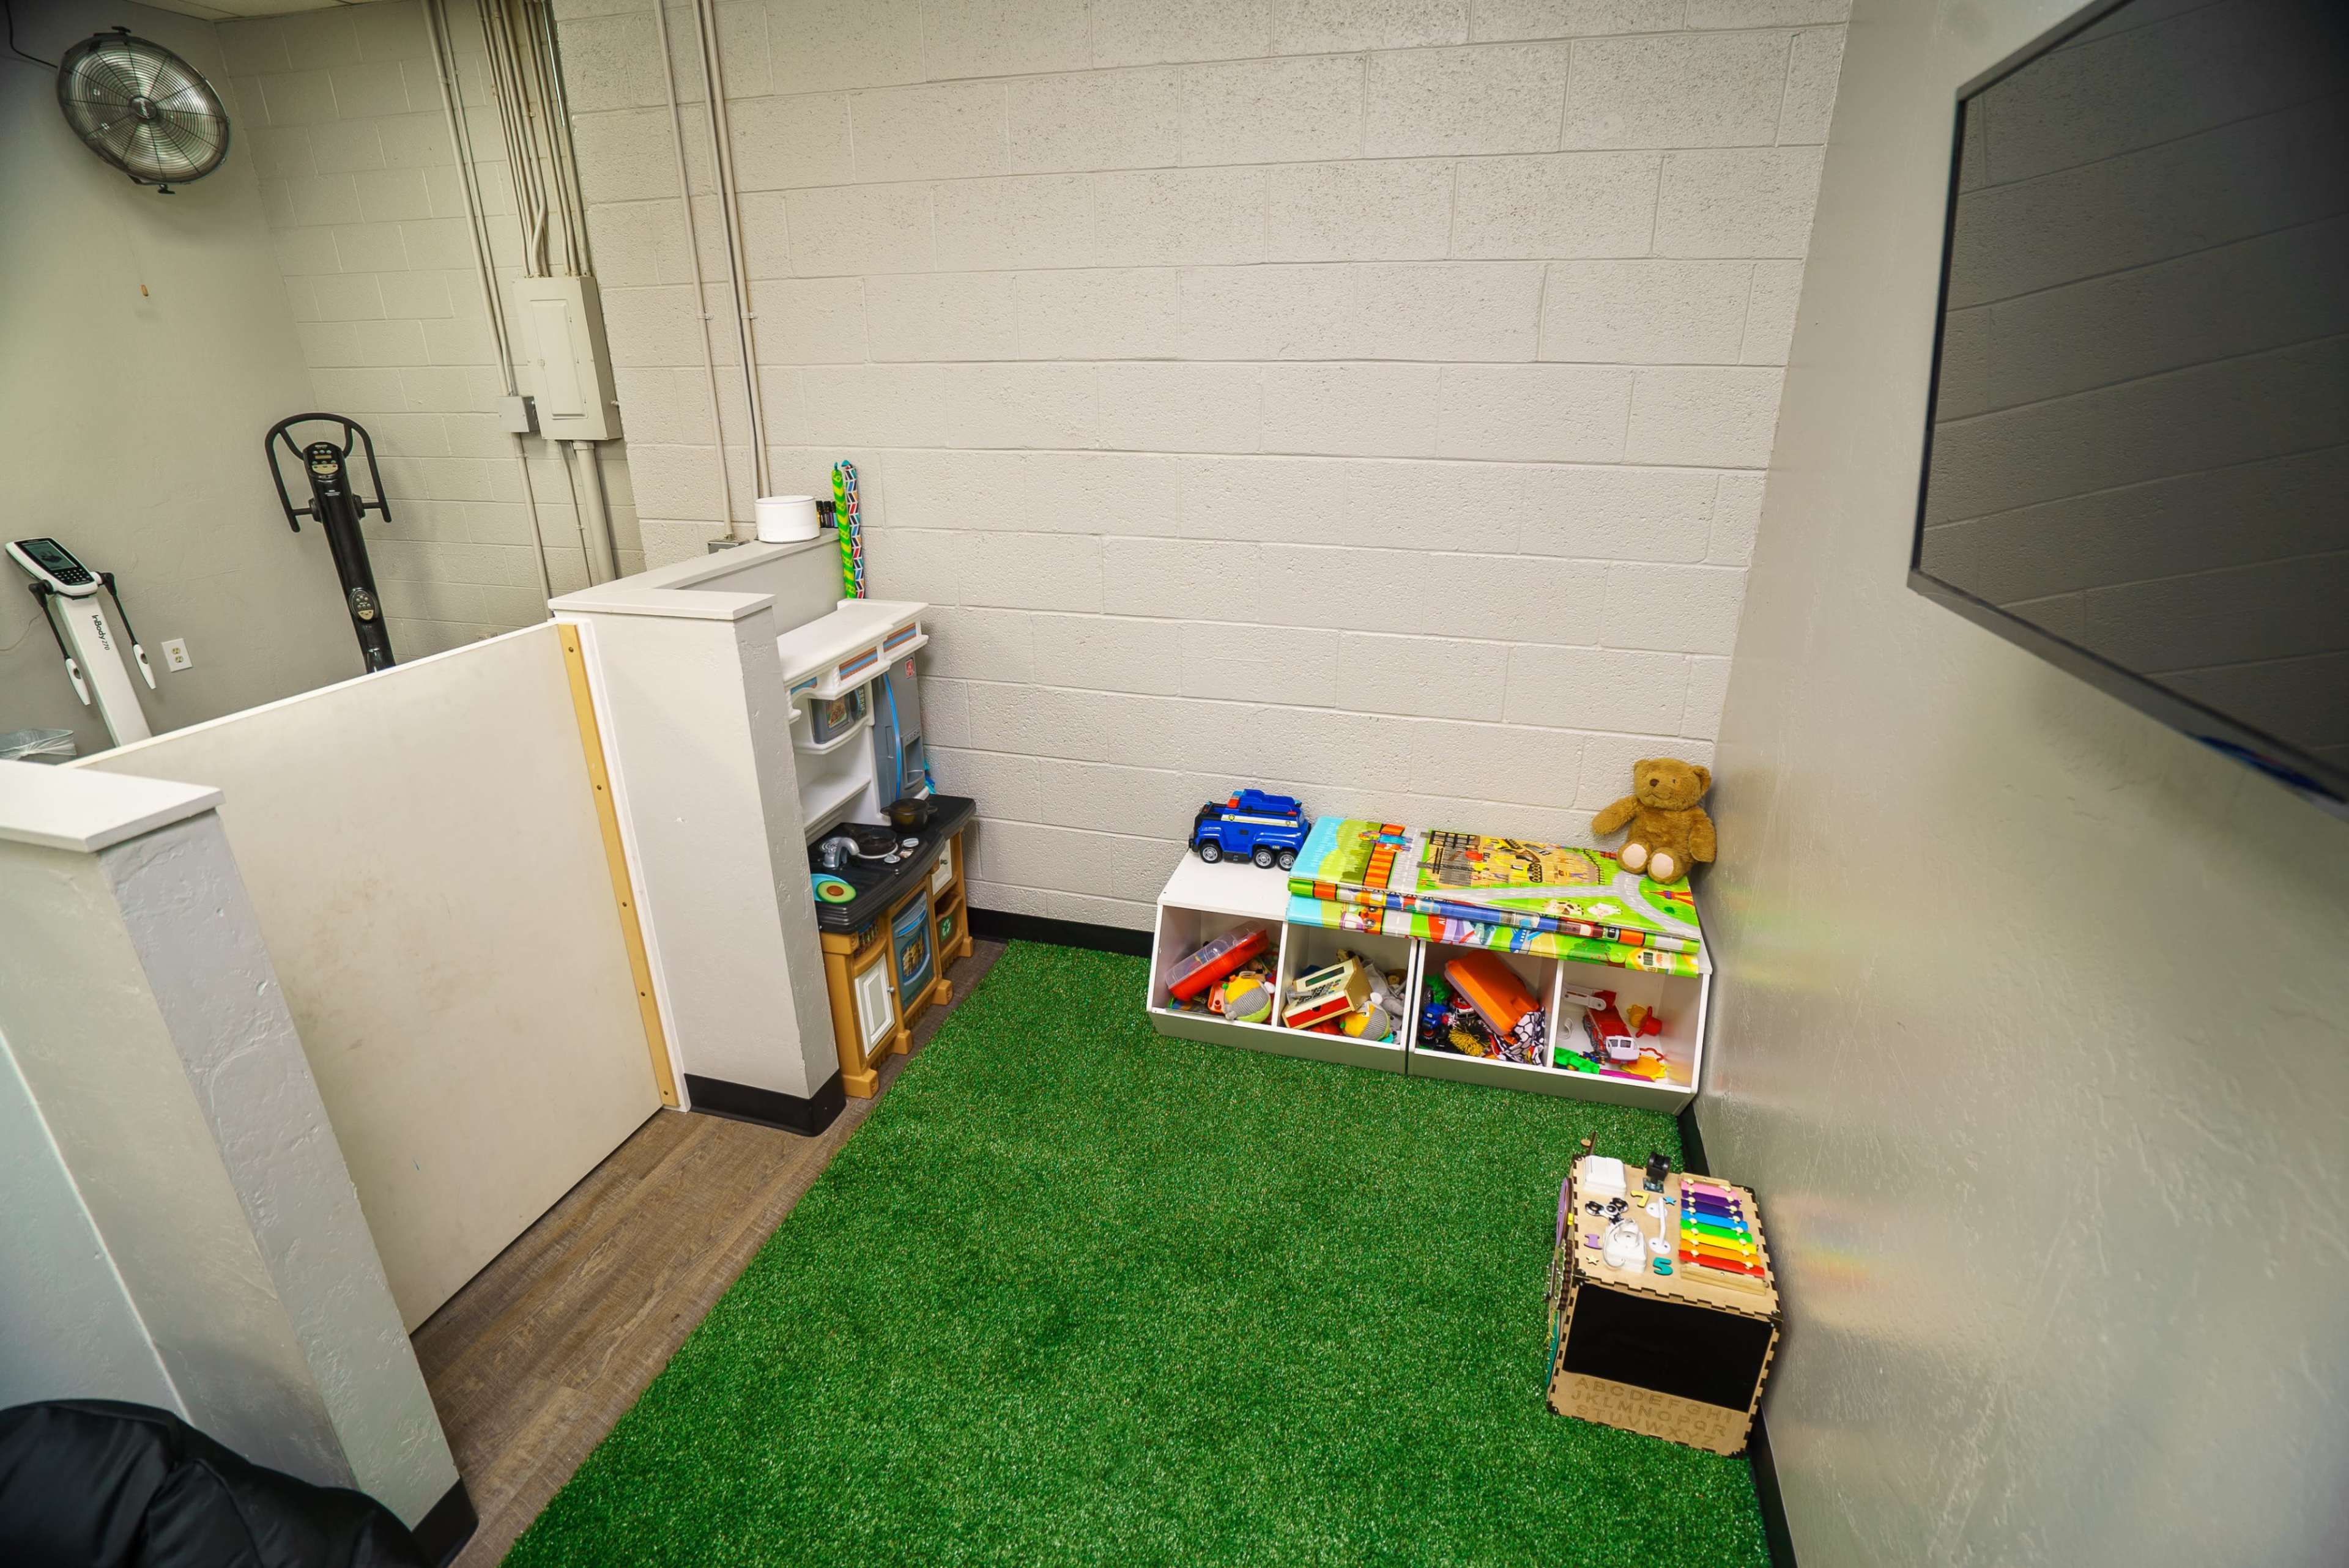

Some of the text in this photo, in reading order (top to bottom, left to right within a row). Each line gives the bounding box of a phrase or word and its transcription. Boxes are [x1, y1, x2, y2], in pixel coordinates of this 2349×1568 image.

[91, 615, 110, 650] InBody 270
[1630, 1189, 1650, 1208] 7
[1653, 1257, 1674, 1276] 5
